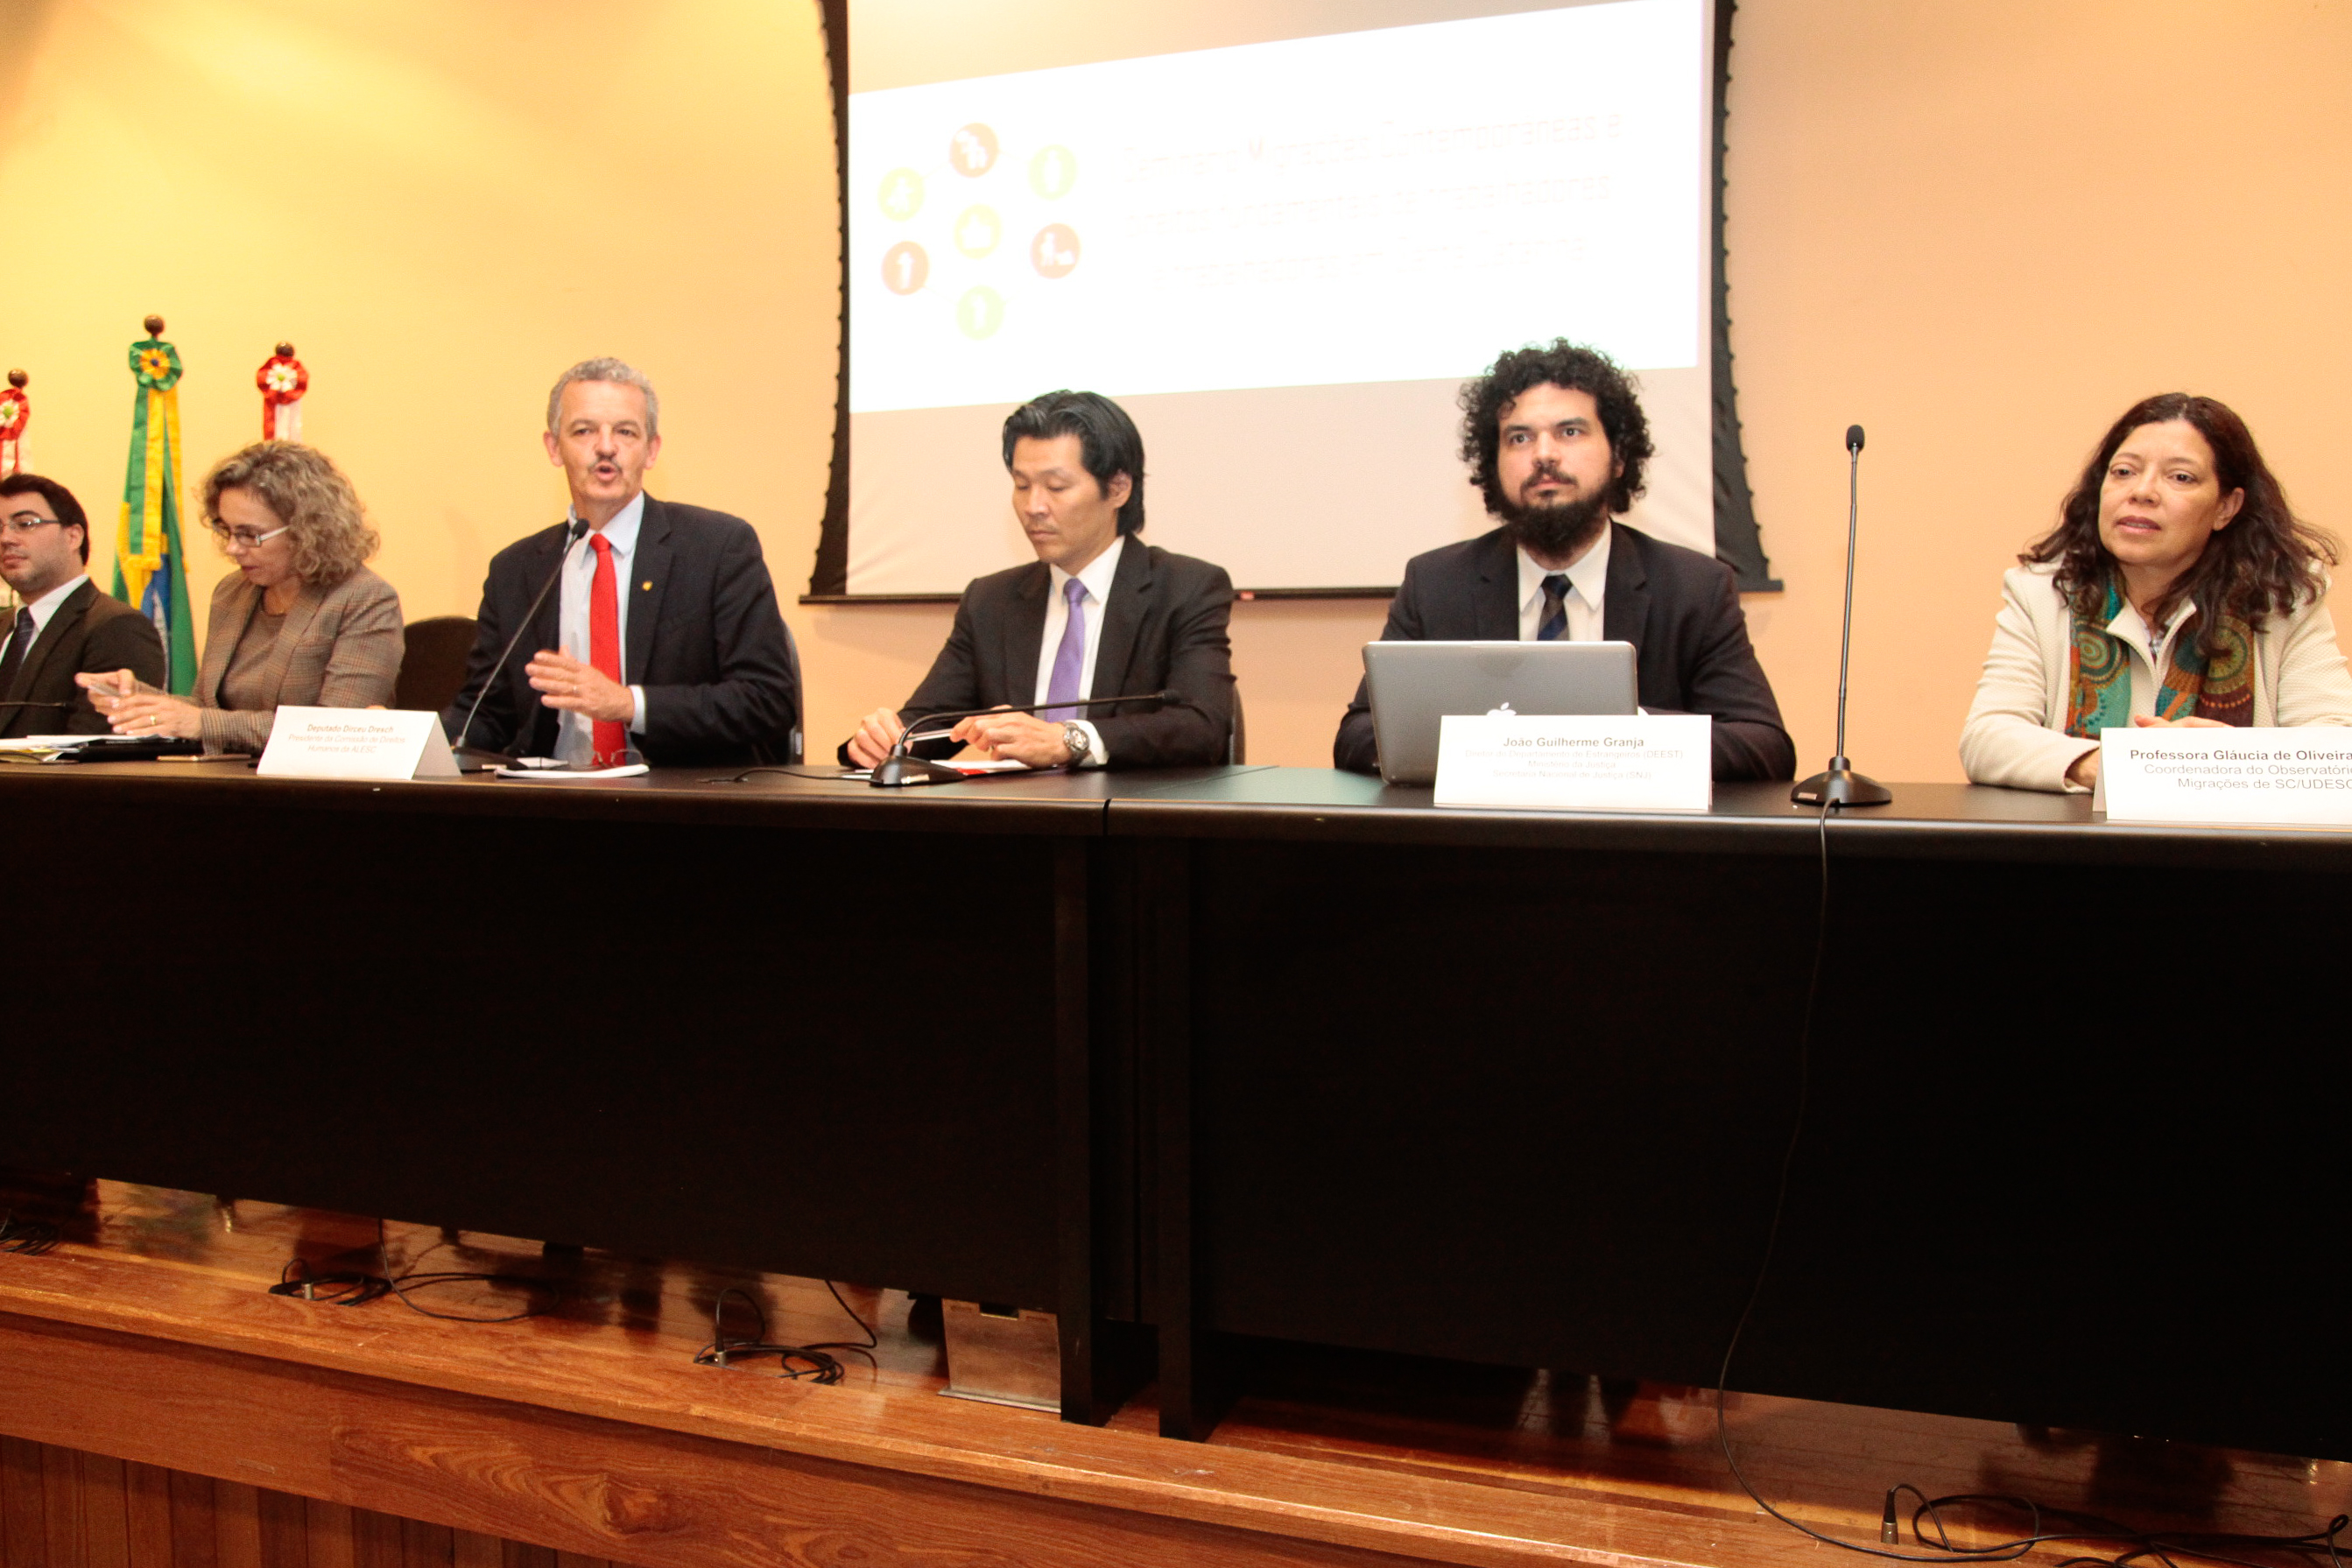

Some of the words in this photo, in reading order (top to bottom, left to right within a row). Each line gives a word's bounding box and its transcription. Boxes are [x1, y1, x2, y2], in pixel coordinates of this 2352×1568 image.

[307, 723, 342, 734] Deputado
[343, 724, 366, 733] Dirceu
[1503, 736, 1532, 747] João
[1537, 736, 1599, 747] Guilherme
[1603, 736, 1644, 749] Granja
[1644, 749, 1683, 759] (DEEST)
[2130, 749, 2208, 760] Professora
[2213, 749, 2269, 761] Gláucia
[2274, 750, 2291, 760] de
[2296, 750, 2352, 761] Oliveira
[2144, 764, 2242, 775] Coordenadora
[2246, 764, 2264, 775] do
[2268, 763, 2352, 776] Observatóri
[2178, 777, 2249, 791] Migrações
[2253, 778, 2271, 789] de
